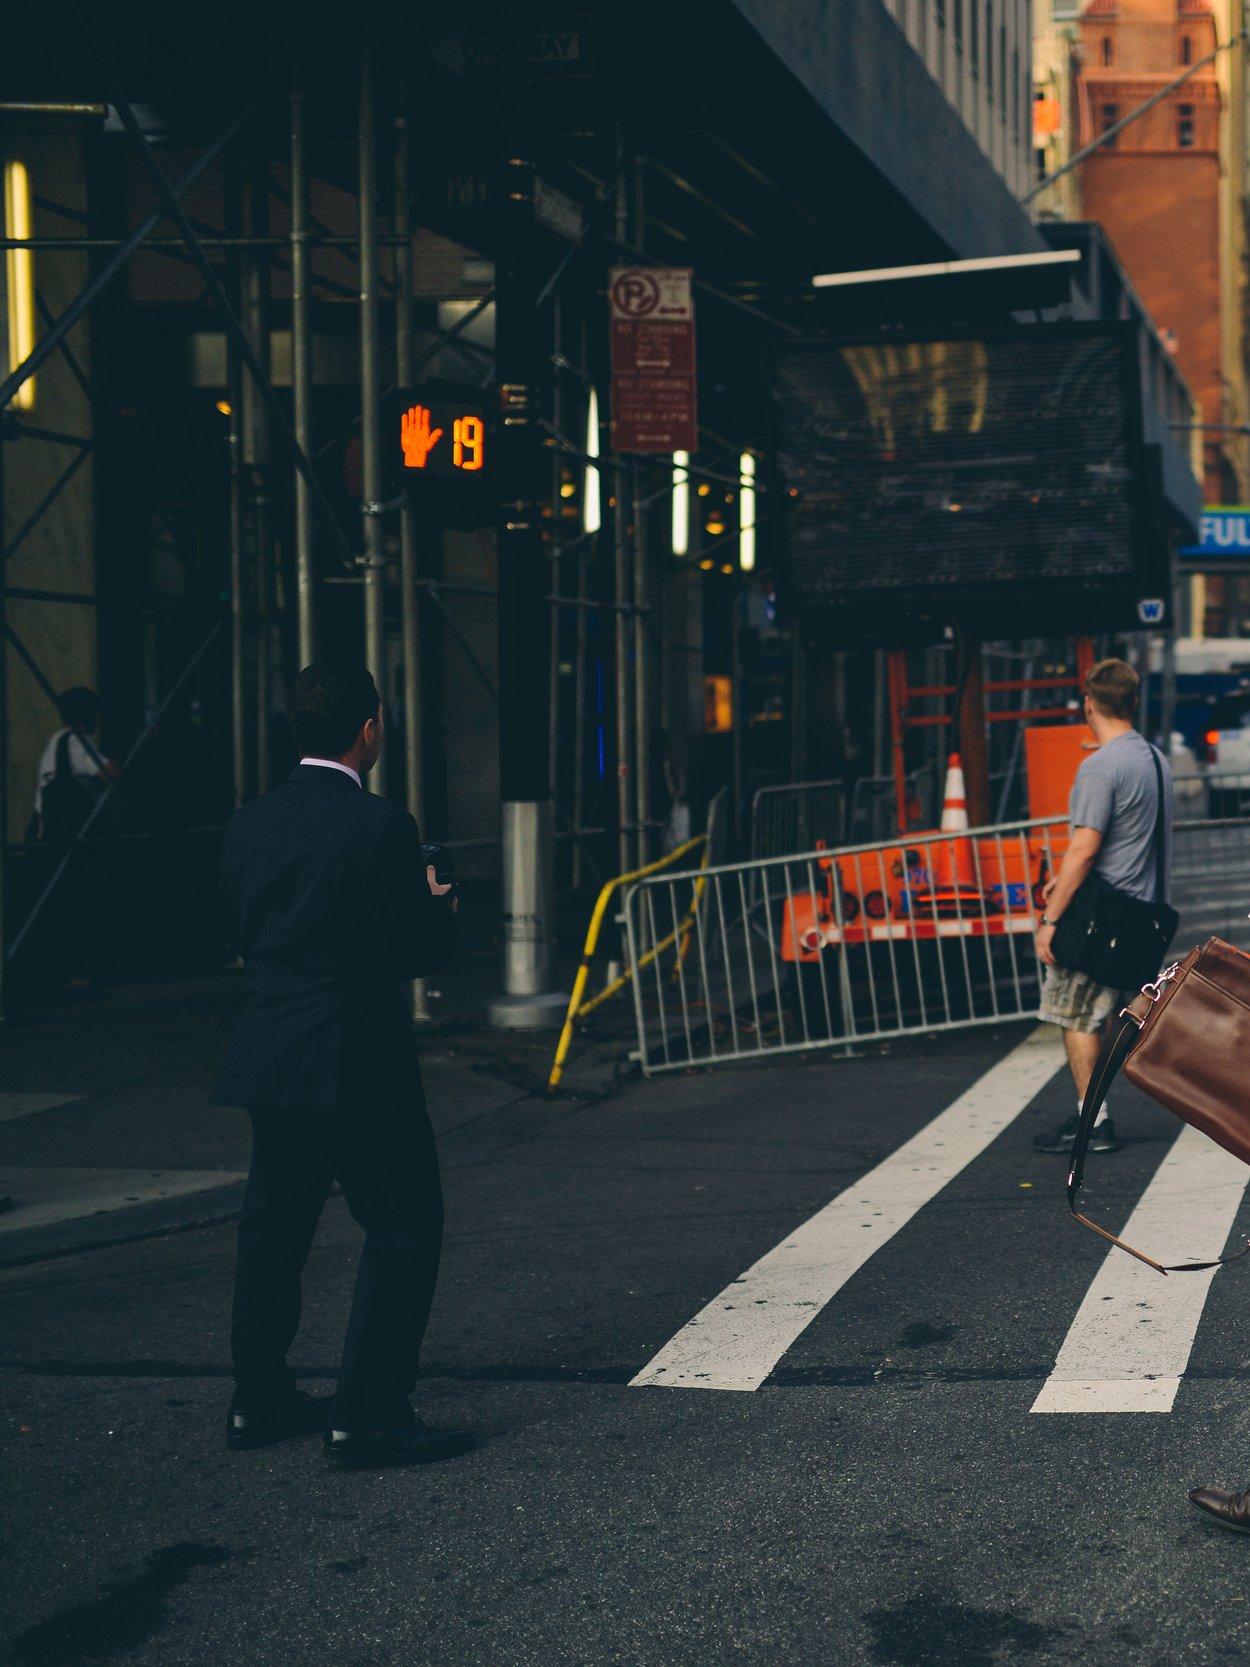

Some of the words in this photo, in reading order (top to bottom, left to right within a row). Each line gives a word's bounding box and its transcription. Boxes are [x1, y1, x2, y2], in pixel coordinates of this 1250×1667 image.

[617, 324, 632, 335] NO
[617, 379, 632, 390] NO
[453, 415, 484, 470] 19
